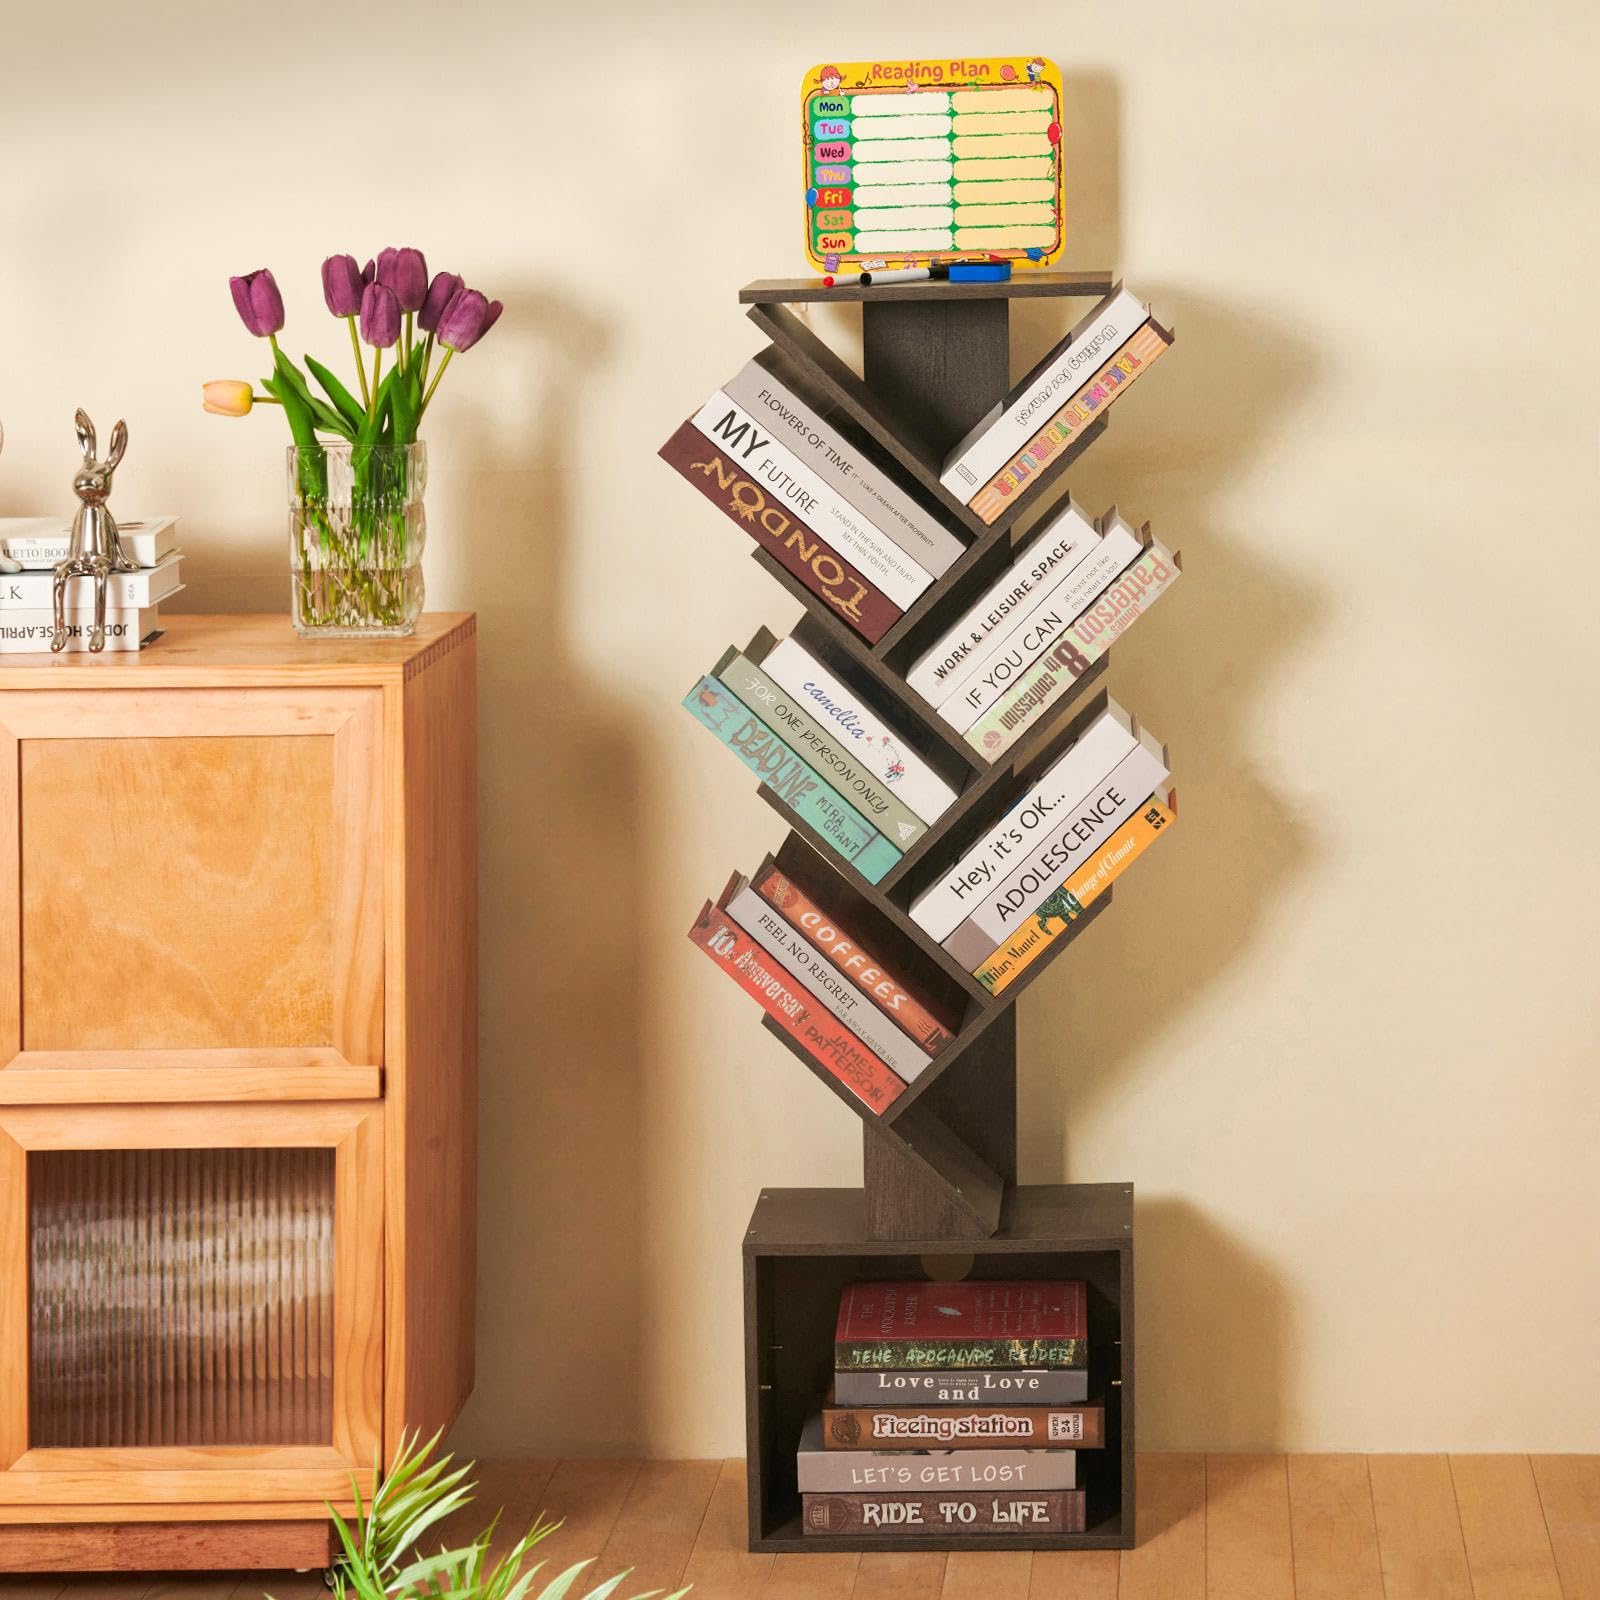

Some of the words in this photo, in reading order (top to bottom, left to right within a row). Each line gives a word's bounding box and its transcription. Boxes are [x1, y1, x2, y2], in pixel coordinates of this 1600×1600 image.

[872, 64, 943, 81] Reading
[950, 62, 989, 77] Plan
[820, 102, 843, 111] Mon
[820, 124, 844, 134] Tue
[821, 147, 844, 157] Wed
[822, 170, 845, 180] Thu
[824, 192, 843, 203] Fri
[824, 214, 844, 225] Sat
[822, 238, 845, 248] Sun
[1067, 322, 1119, 370] Waiting
[1050, 368, 1074, 393] for
[1100, 350, 1142, 393] TAKE
[1062, 401, 1090, 431] TO
[1081, 382, 1109, 413] ME
[757, 388, 810, 438] FLOWERS
[806, 432, 826, 452] OF
[822, 446, 854, 476] TIME
[1028, 420, 1070, 462] YOUR
[712, 407, 770, 465] MY
[757, 458, 819, 515] FUTURE
[45, 548, 67, 558] BOO
[690, 455, 870, 623] LONDON
[858, 532, 872, 545] THE
[933, 641, 972, 681] WORK
[969, 630, 983, 644] &
[980, 579, 1033, 633] LEISURE
[1030, 538, 1073, 582] SPACE
[1072, 552, 1173, 648] Patterson
[1109, 602, 1143, 635] James
[964, 686, 987, 710] IF
[982, 648, 1025, 693] YOU
[1020, 610, 1064, 655] CAN
[802, 679, 865, 741] camellia
[998, 671, 1058, 733] confession
[728, 716, 817, 811] DEADLINE
[772, 702, 803, 733] ONE
[799, 727, 857, 783] PERSON
[850, 776, 890, 816] ONLY
[815, 796, 848, 827] MIRA
[822, 819, 861, 856] GRANT
[950, 860, 997, 900] Hey,
[990, 826, 1024, 860] it's
[1018, 793, 1067, 833] OK...
[991, 786, 1126, 922] ADOLESCENCE
[1094, 862, 1110, 881] of
[1102, 835, 1139, 872] Climate
[757, 913, 790, 946] FEEL
[786, 941, 812, 967] NO
[807, 961, 859, 1013] REGRET
[797, 907, 910, 1011] COFFEES
[982, 953, 1016, 986] Hilary
[1006, 927, 1041, 964] Mantel
[804, 1025, 885, 1103] PATTERSON
[830, 1033, 878, 1078] JAMES
[879, 1374, 934, 1388] Love
[984, 1375, 1040, 1389] Love
[939, 1386, 979, 1400] and
[959, 1417, 1030, 1433] station
[1062, 1420, 1070, 1433] 24
[852, 1467, 911, 1484] LET'S
[921, 1466, 962, 1482] GET
[971, 1464, 1026, 1481] LOST
[863, 1502, 923, 1527] RIDE
[939, 1503, 977, 1523] TO
[992, 1498, 1050, 1527] LIFE
